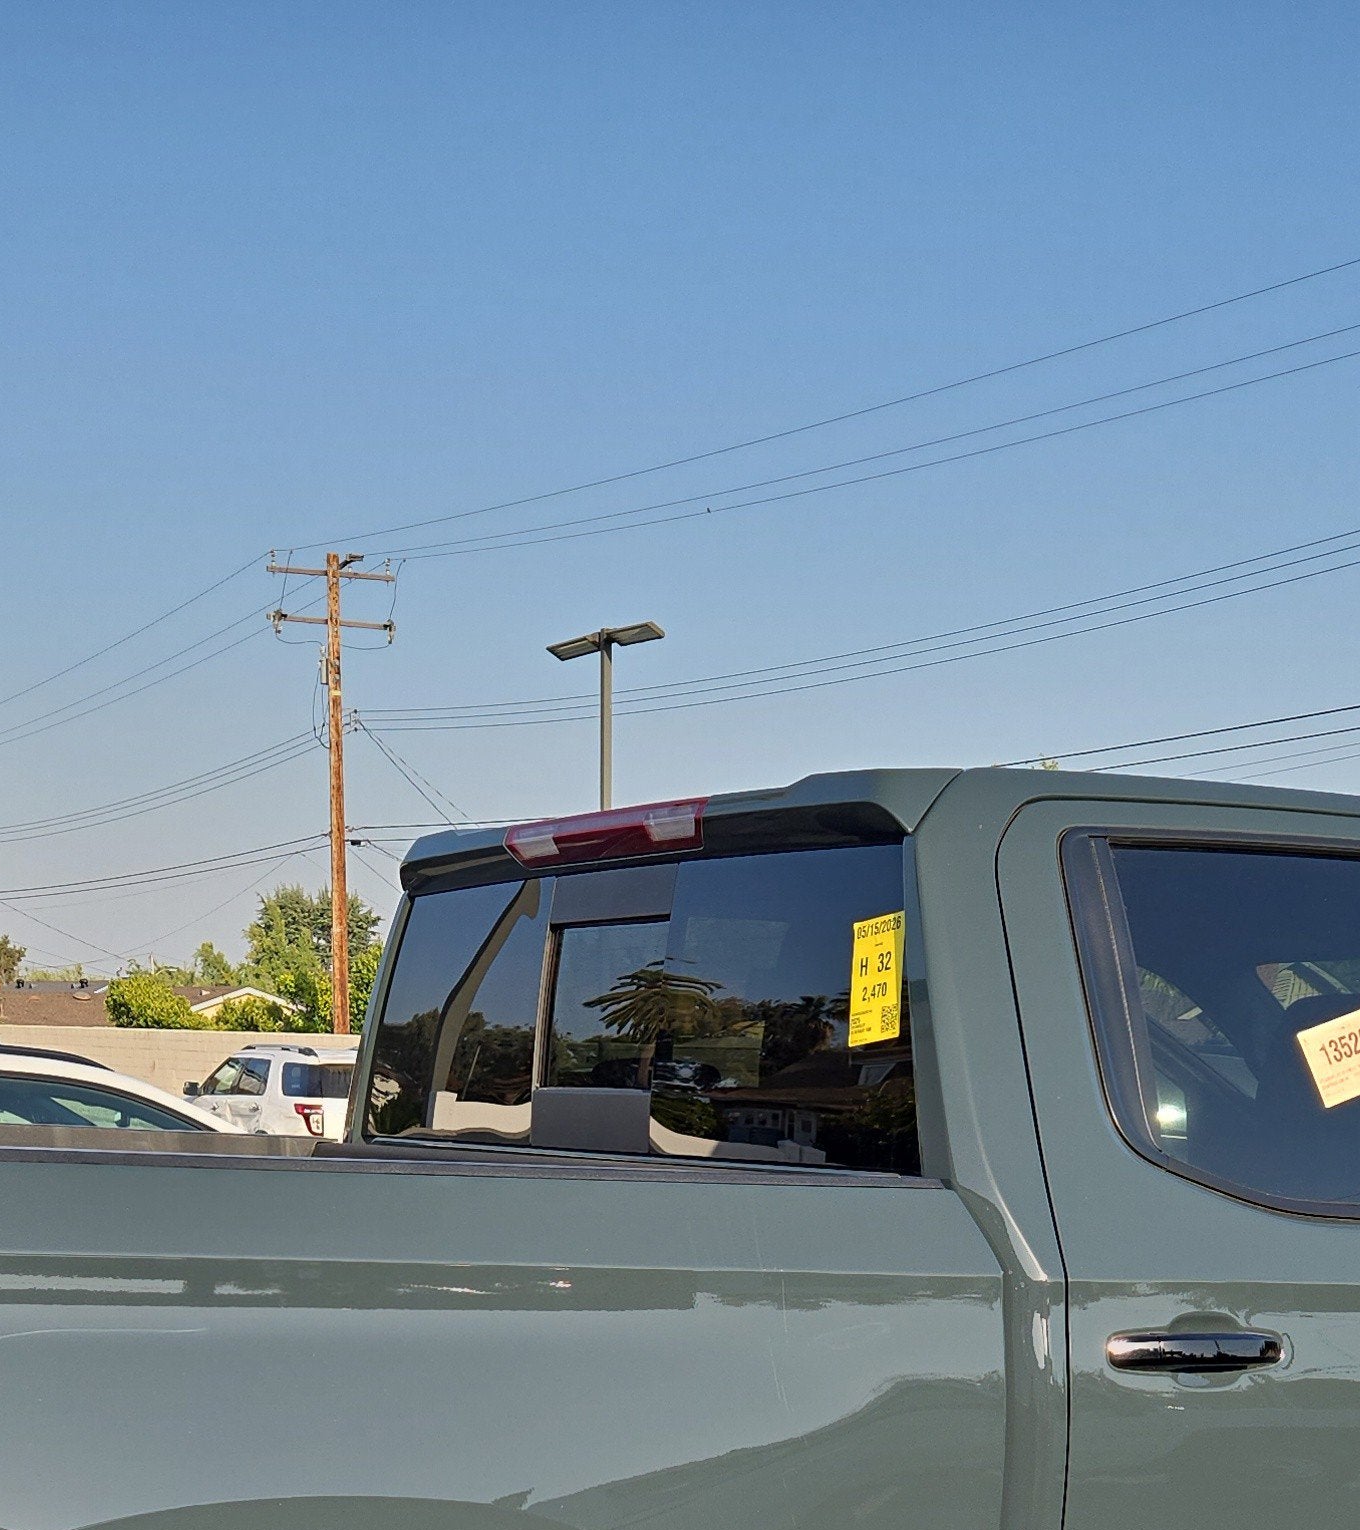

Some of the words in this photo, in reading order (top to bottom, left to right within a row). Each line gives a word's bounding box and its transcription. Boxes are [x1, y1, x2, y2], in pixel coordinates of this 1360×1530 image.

[856, 915, 902, 939] 05/15/2026
[859, 956, 869, 977] H
[877, 951, 892, 972] 32
[861, 981, 888, 1002] 2,470
